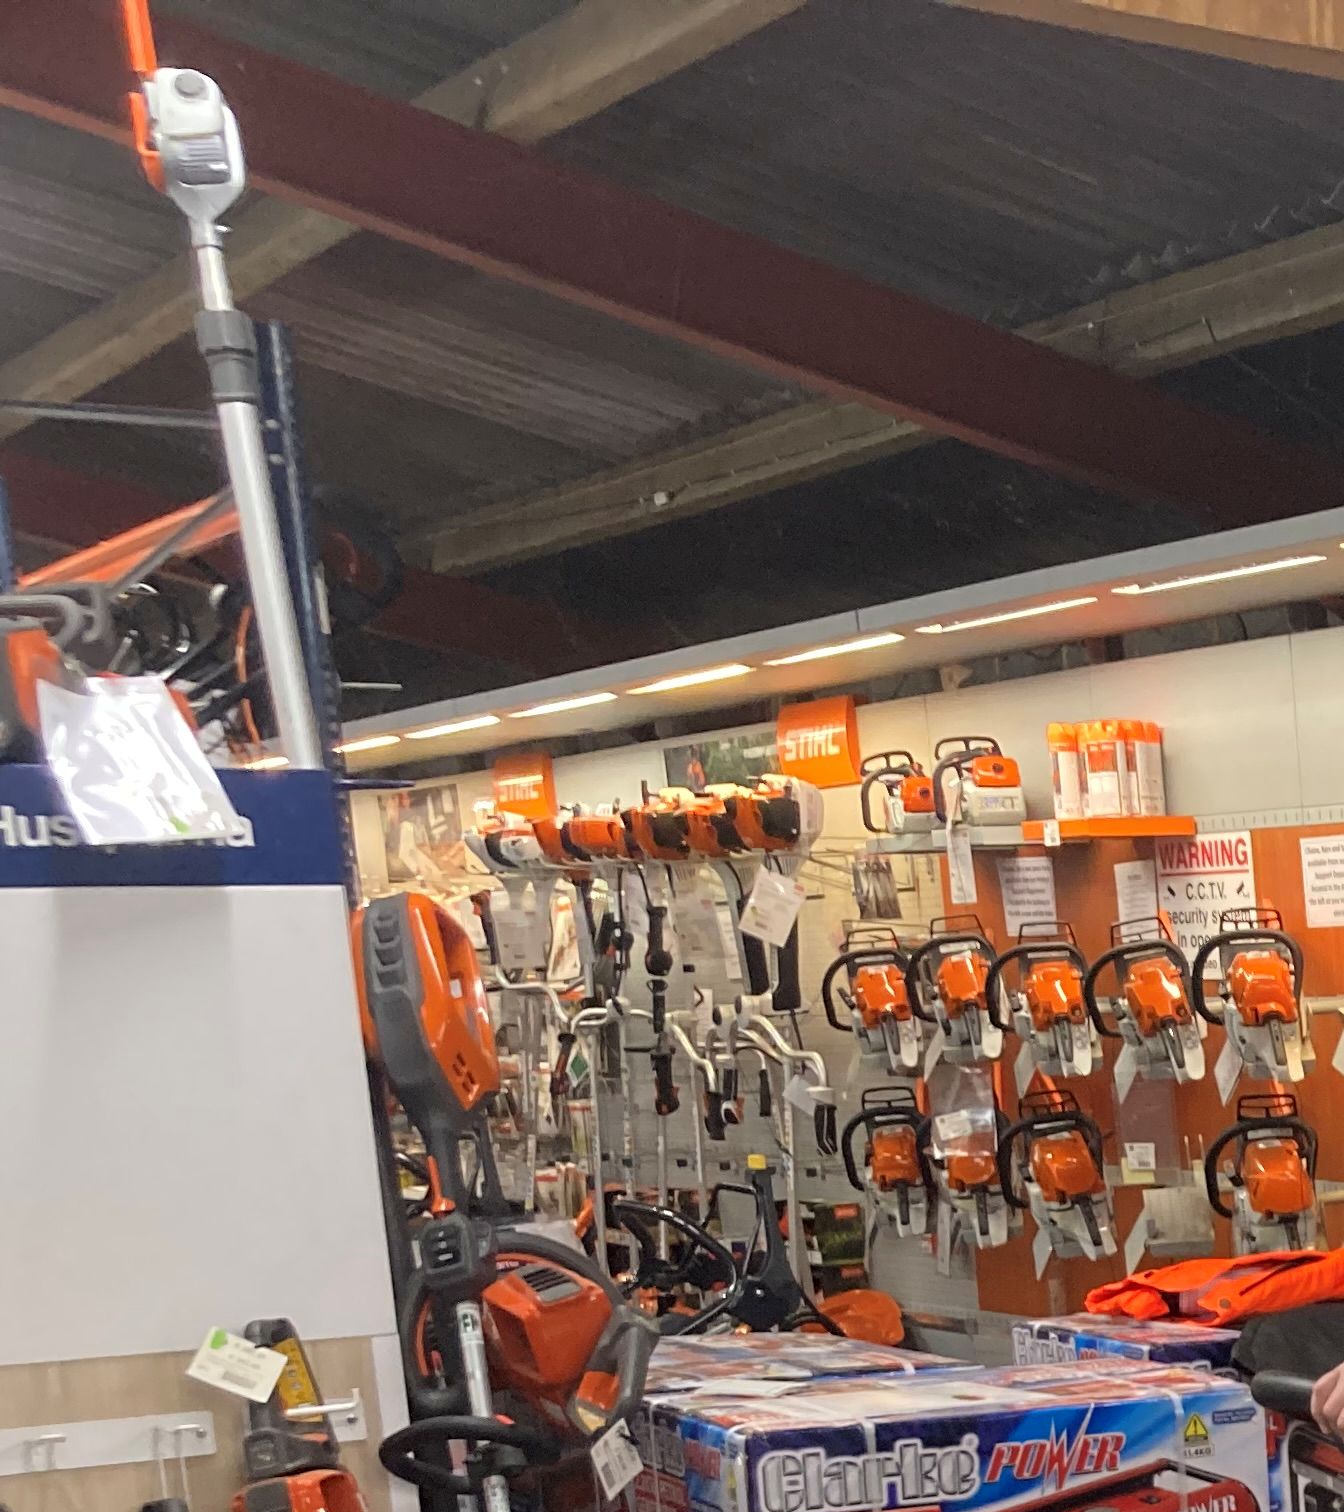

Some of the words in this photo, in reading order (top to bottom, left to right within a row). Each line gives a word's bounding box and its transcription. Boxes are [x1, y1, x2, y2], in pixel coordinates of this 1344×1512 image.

[784, 725, 841, 763] STIHL
[1158, 837, 1249, 871] WARNING
[1185, 881, 1227, 901] C.C.T.V.
[1168, 909, 1210, 926] security
[986, 1403, 1127, 1490] POWER
